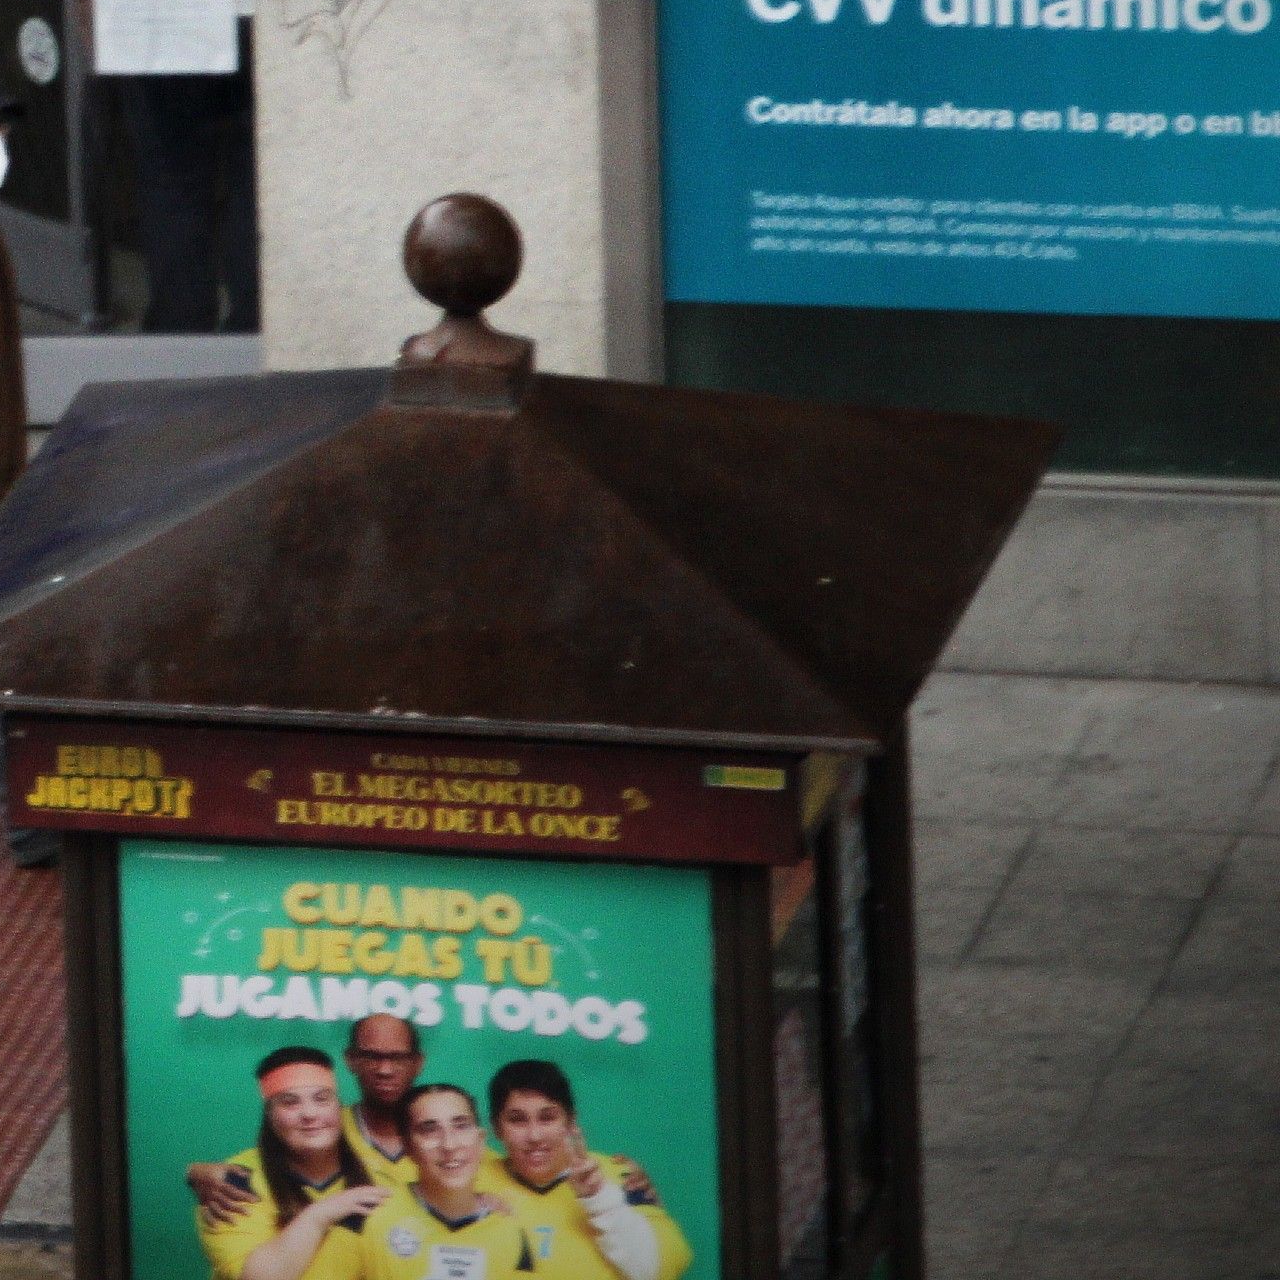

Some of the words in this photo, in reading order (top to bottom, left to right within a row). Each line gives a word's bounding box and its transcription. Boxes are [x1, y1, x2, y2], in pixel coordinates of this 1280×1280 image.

[747, 96, 917, 127] Contrátala
[924, 102, 1014, 130] ahora
[1021, 107, 1061, 132] en
[1068, 106, 1099, 133] la
[1105, 111, 1167, 138] app
[1174, 113, 1195, 135] o
[1202, 113, 1242, 137] en
[26, 775, 192, 818] JACKPOT
[312, 772, 351, 797] EL
[357, 773, 582, 808] MEGASORTEO
[276, 800, 429, 830] EUROPEO
[434, 808, 476, 833] DE
[482, 811, 526, 837] LA
[530, 814, 622, 842] ONCE
[282, 881, 523, 936] CUANDO
[258, 927, 462, 980] JUEGAS
[475, 934, 553, 987] TÚ
[177, 974, 444, 1027] JUGAMOS
[455, 983, 649, 1046] TODOS
